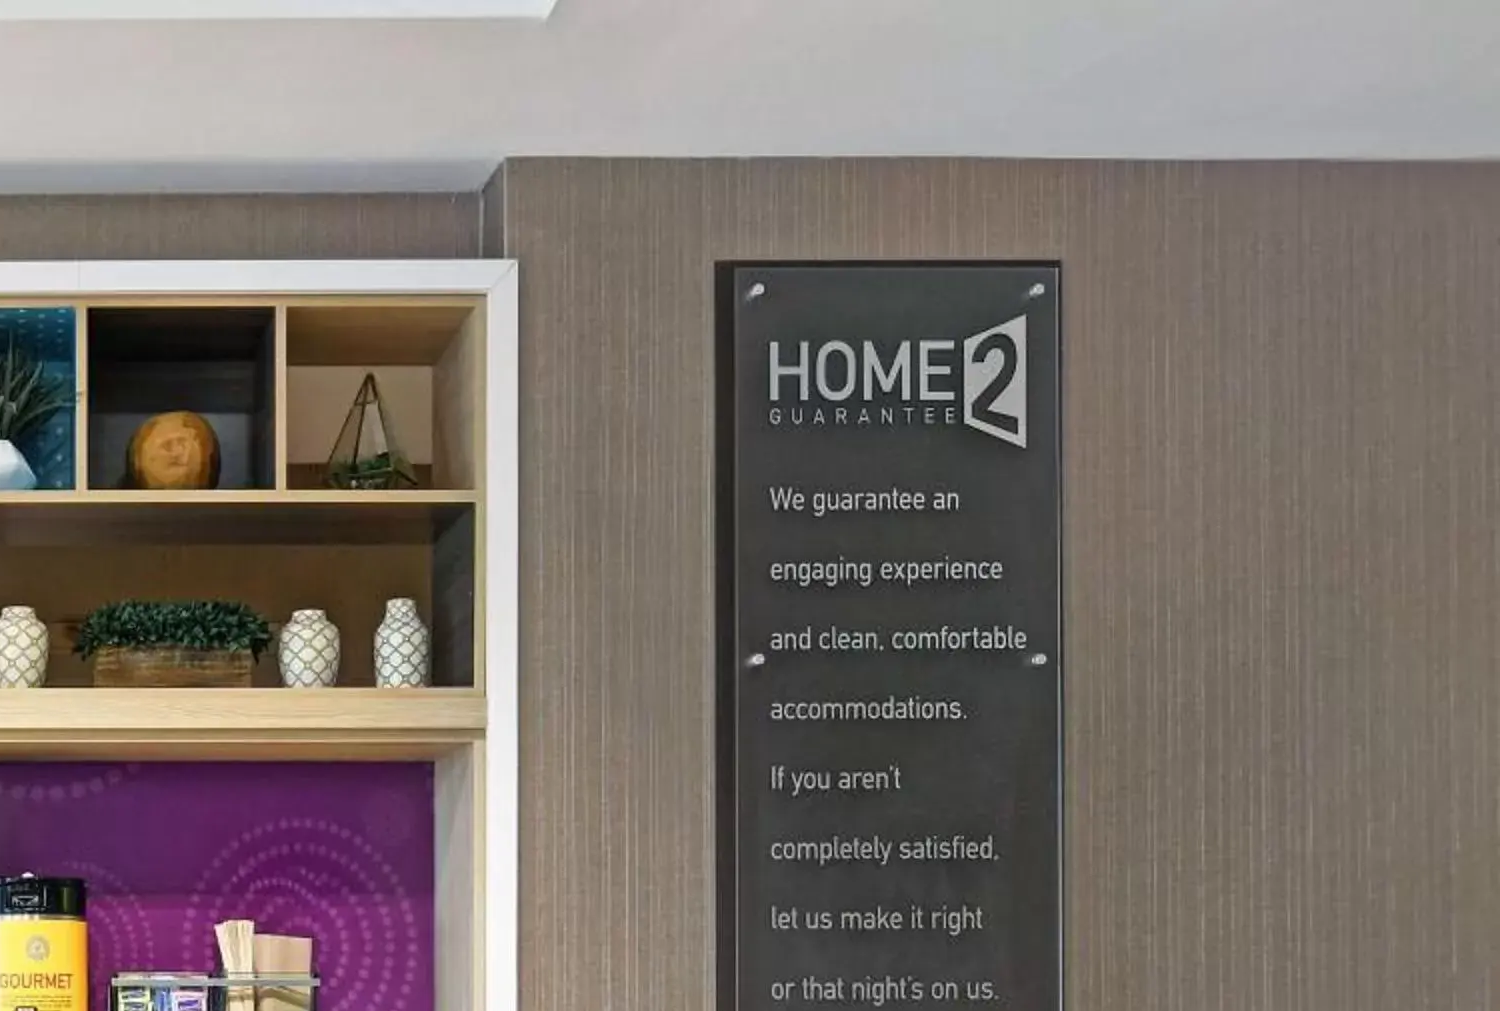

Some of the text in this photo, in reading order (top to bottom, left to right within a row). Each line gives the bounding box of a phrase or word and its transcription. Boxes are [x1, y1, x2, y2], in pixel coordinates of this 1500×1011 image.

[769, 406, 956, 425] GUARANTEE
[769, 486, 960, 517] We guarantee an
[770, 556, 1003, 586] engaging experience
[770, 625, 812, 650] and
[891, 625, 1028, 650] comfortable
[770, 695, 968, 720] accommodations.
[771, 765, 901, 796] If you aren't
[771, 835, 893, 865] completely
[771, 905, 983, 936] let us make it right
[0, 973, 74, 989] GOURMET
[771, 975, 999, 1006] or that night's on us.
